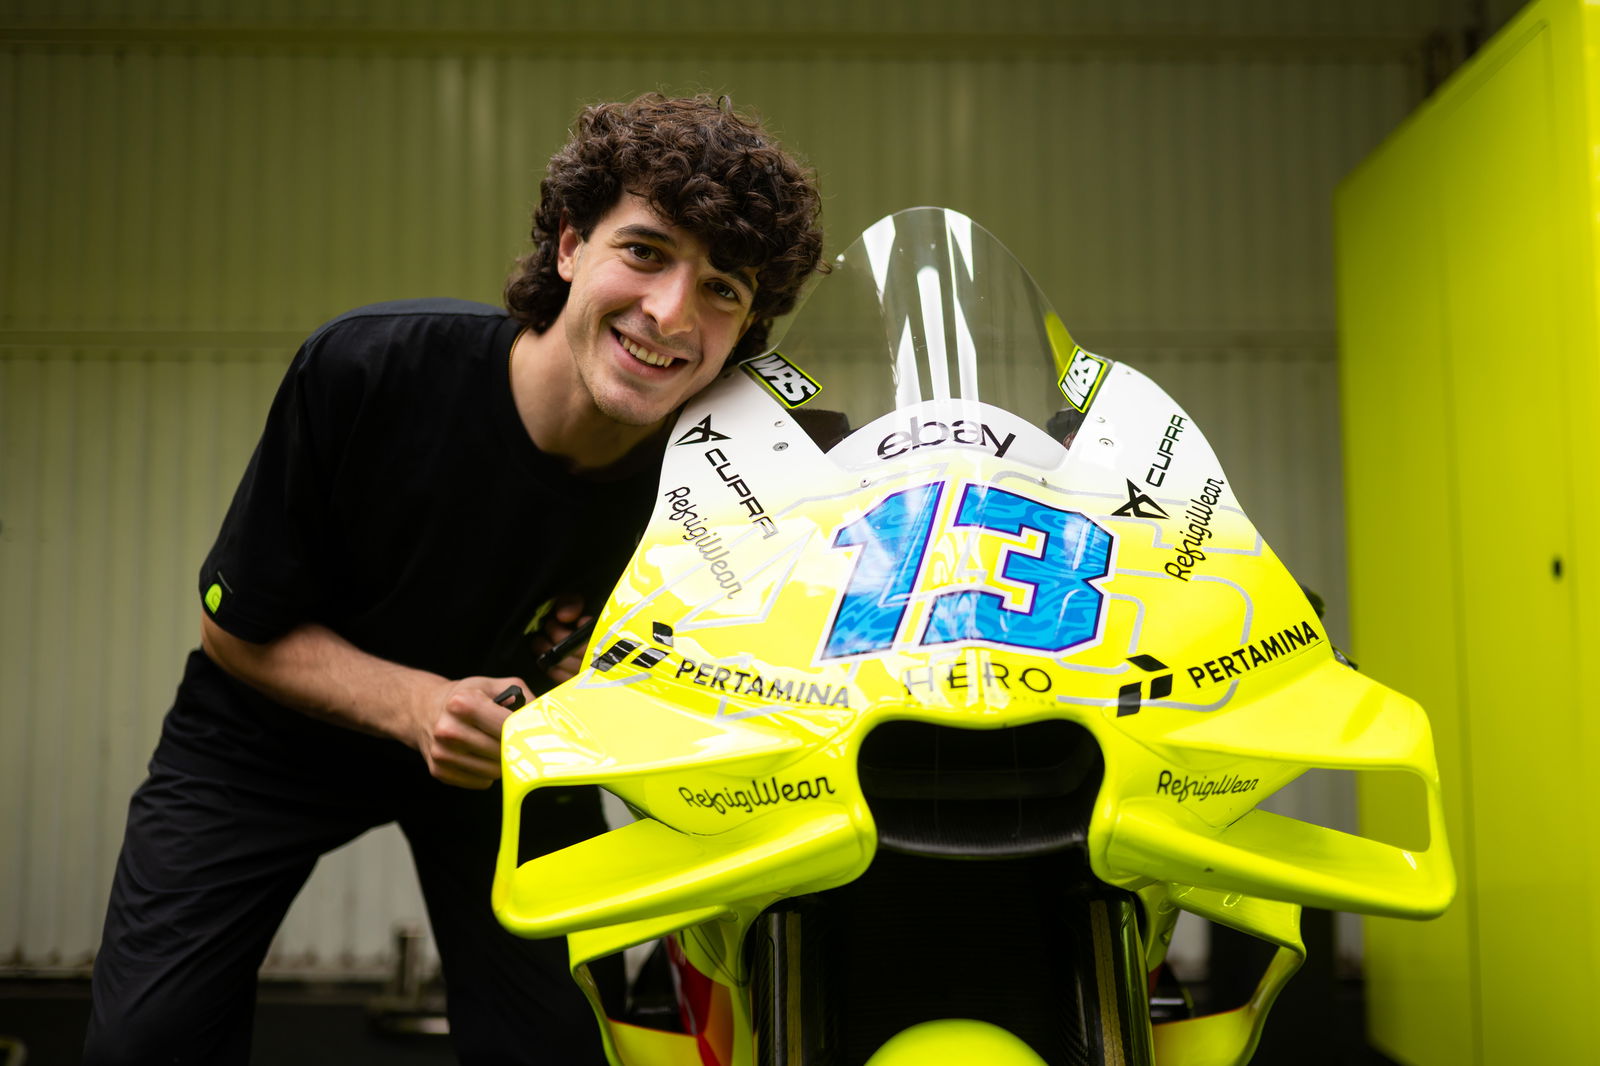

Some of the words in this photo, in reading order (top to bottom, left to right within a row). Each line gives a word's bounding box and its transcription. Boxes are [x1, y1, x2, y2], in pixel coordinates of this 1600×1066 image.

[877, 416, 1016, 460] ebay
[1145, 414, 1188, 488] CUPRA
[704, 448, 779, 540] CUPRA
[811, 476, 1119, 666] 13
[675, 657, 850, 709] PERTAMINA
[903, 661, 1053, 696] HERO
[1187, 620, 1321, 689] PERTAMINA
